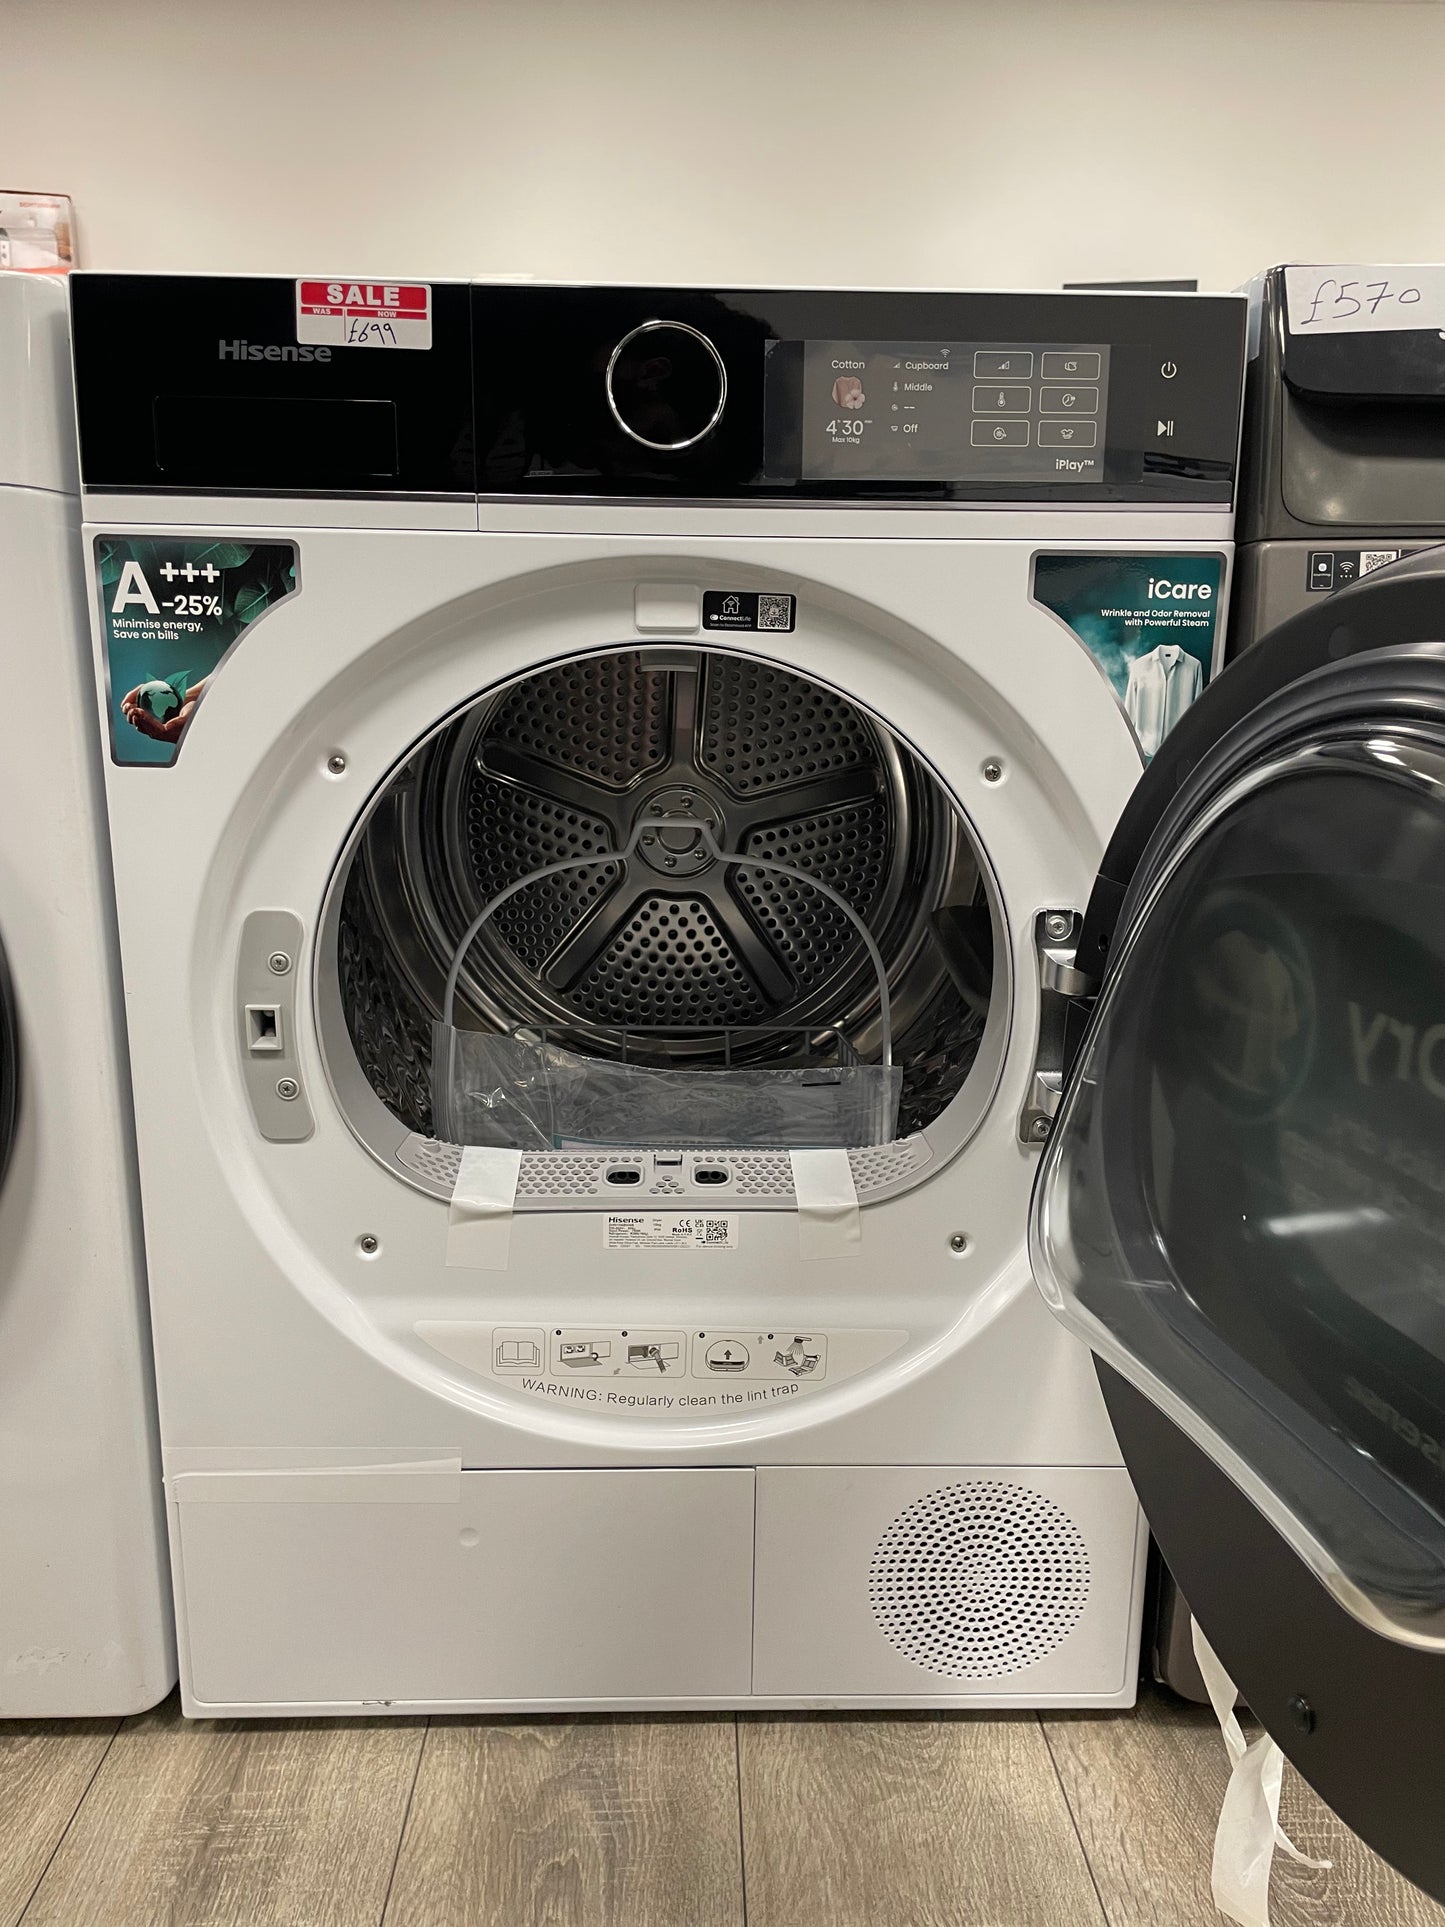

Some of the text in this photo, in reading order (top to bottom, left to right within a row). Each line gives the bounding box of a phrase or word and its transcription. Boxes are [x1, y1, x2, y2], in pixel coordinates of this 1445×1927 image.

[326, 284, 400, 307] SALE
[1300, 279, 1421, 325] £570
[312, 307, 332, 316] WAS
[377, 310, 397, 318] NOW
[347, 318, 397, 345] £699
[218, 339, 332, 363] Hisense
[831, 360, 866, 369] Cotton
[905, 361, 949, 371] Cupboard
[904, 383, 933, 392] Middle
[903, 423, 919, 433] Off
[846, 436, 861, 445] 10kg
[1148, 577, 1212, 600] iCare
[161, 594, 223, 617] -25%
[1101, 608, 1211, 618] Wrinkle and Odor Removal
[112, 618, 204, 632] Minimise energy,
[1124, 618, 1210, 627] with Powerful Steam
[113, 630, 180, 640] Save on bills
[608, 1216, 645, 1224] Hisense
[522, 1377, 799, 1408] WARNING: Regularly clean the lint trap
